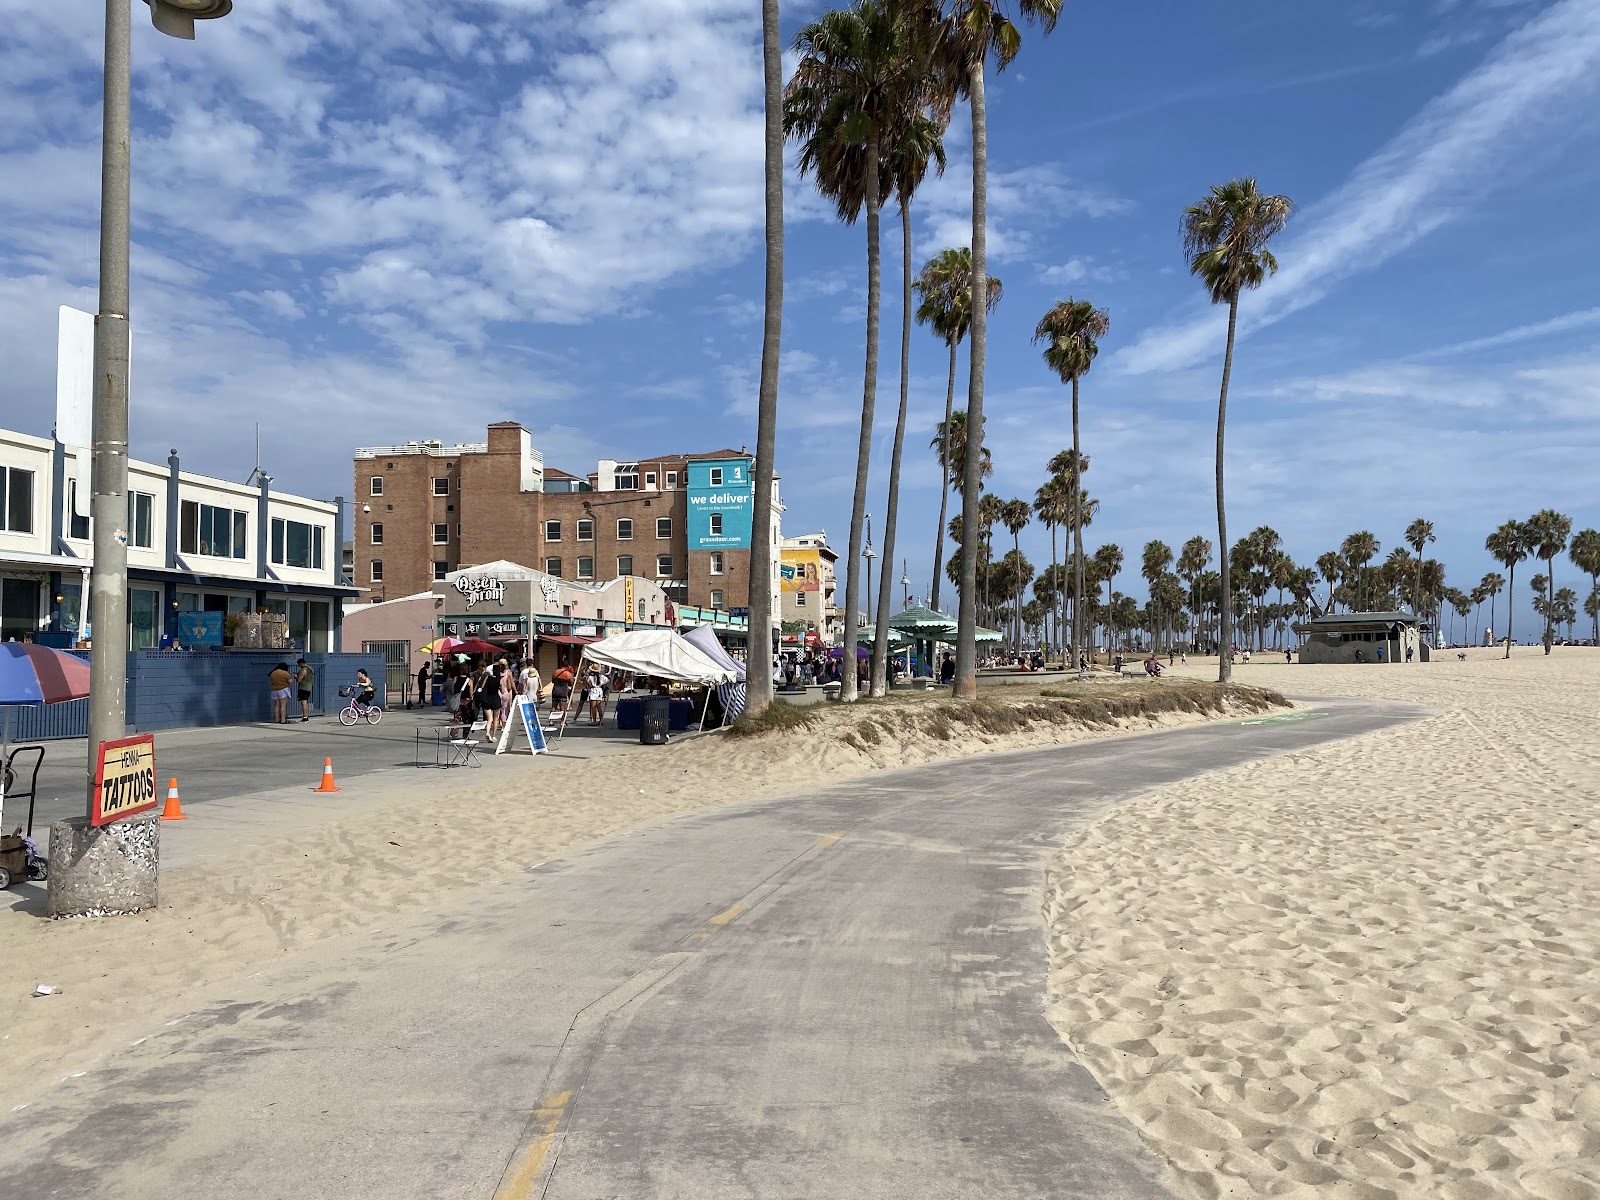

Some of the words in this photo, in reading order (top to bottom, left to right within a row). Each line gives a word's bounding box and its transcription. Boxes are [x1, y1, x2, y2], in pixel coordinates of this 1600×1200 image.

[690, 496, 706, 504] we
[709, 493, 749, 503] deliver
[452, 575, 498, 595] Ocean
[466, 581, 507, 611] Front
[121, 750, 140, 768] HENNA
[104, 768, 153, 812] TATTOOS
